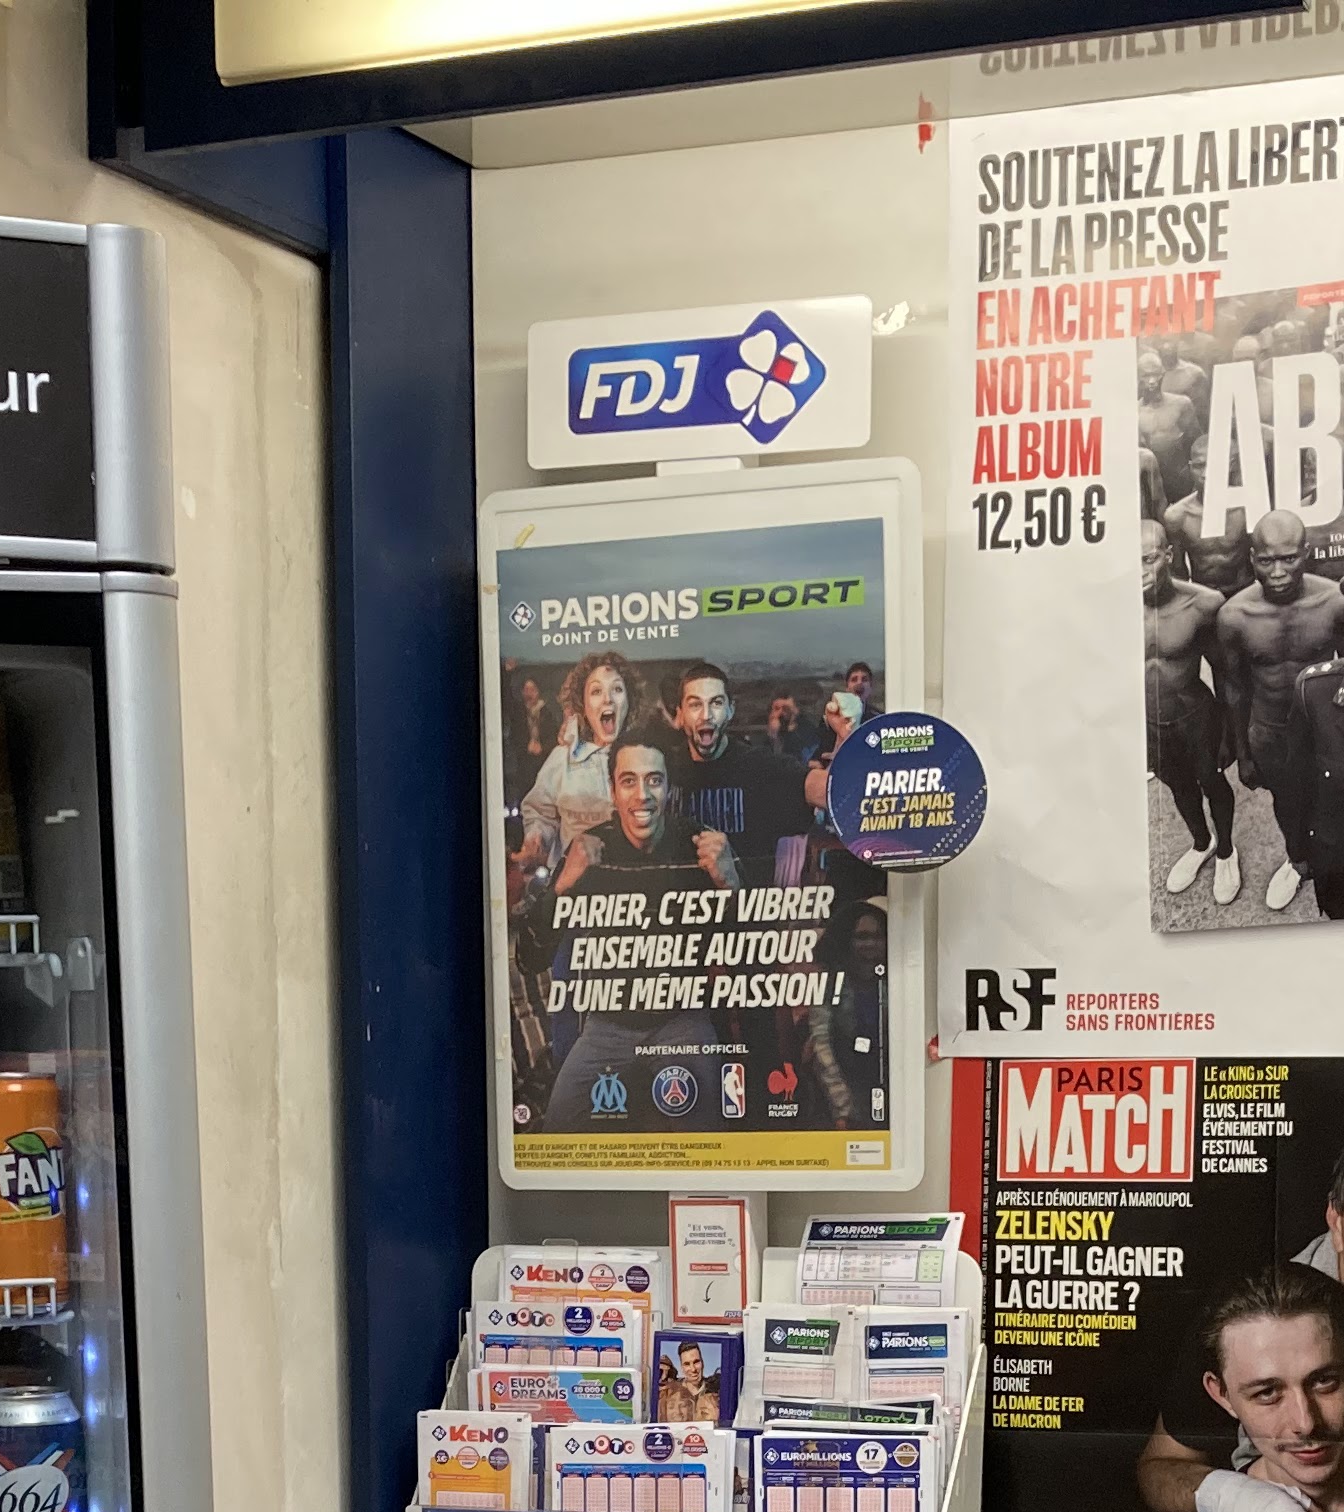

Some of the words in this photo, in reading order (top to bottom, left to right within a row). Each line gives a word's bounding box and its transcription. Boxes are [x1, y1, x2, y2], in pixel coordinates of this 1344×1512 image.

[979, 137, 1165, 214] SOUTENEZ
[1173, 130, 1220, 195] LA
[976, 287, 1022, 349] EN
[1030, 272, 1220, 344] ACHETANT
[579, 354, 700, 419] FDJ
[976, 350, 1091, 416] NOTRE
[973, 417, 1102, 484] ALBUM
[973, 488, 1069, 552] 12,50
[1081, 484, 1105, 543] €
[541, 588, 699, 630] PARIONS
[707, 579, 860, 614] SPORT
[859, 795, 897, 816] C'EST
[902, 792, 955, 813] JAMAIS
[553, 894, 652, 930] PARIER,
[658, 890, 731, 925] C'EST
[738, 886, 834, 921] VIBRER
[570, 934, 698, 971] ENSEMBLE
[705, 929, 817, 965] AUTOUR
[966, 968, 1056, 1031] RSF
[1066, 994, 1160, 1011] REPORTERS
[1066, 1014, 1108, 1031] SANS
[1116, 1011, 1215, 1031] FRONTIÈRES
[635, 1045, 697, 1056] PARTENAIRE
[700, 1043, 749, 1054] OFFICIEL
[1058, 1067, 1143, 1092] PARIS
[1006, 1066, 1188, 1174] MATCH
[1202, 1140, 1257, 1155] FESTIVAL
[995, 1210, 1114, 1241] ZELENSKY
[527, 1264, 584, 1283] KENO
[995, 1245, 1083, 1276] PEUT-IL
[1087, 1246, 1184, 1278] GAGNER
[995, 1280, 1022, 1309] LA
[1025, 1280, 1119, 1311] GUERRE
[510, 1377, 545, 1389] EURO
[511, 1388, 567, 1400] DREAMS
[781, 1451, 852, 1462] EUROMILLIONS
